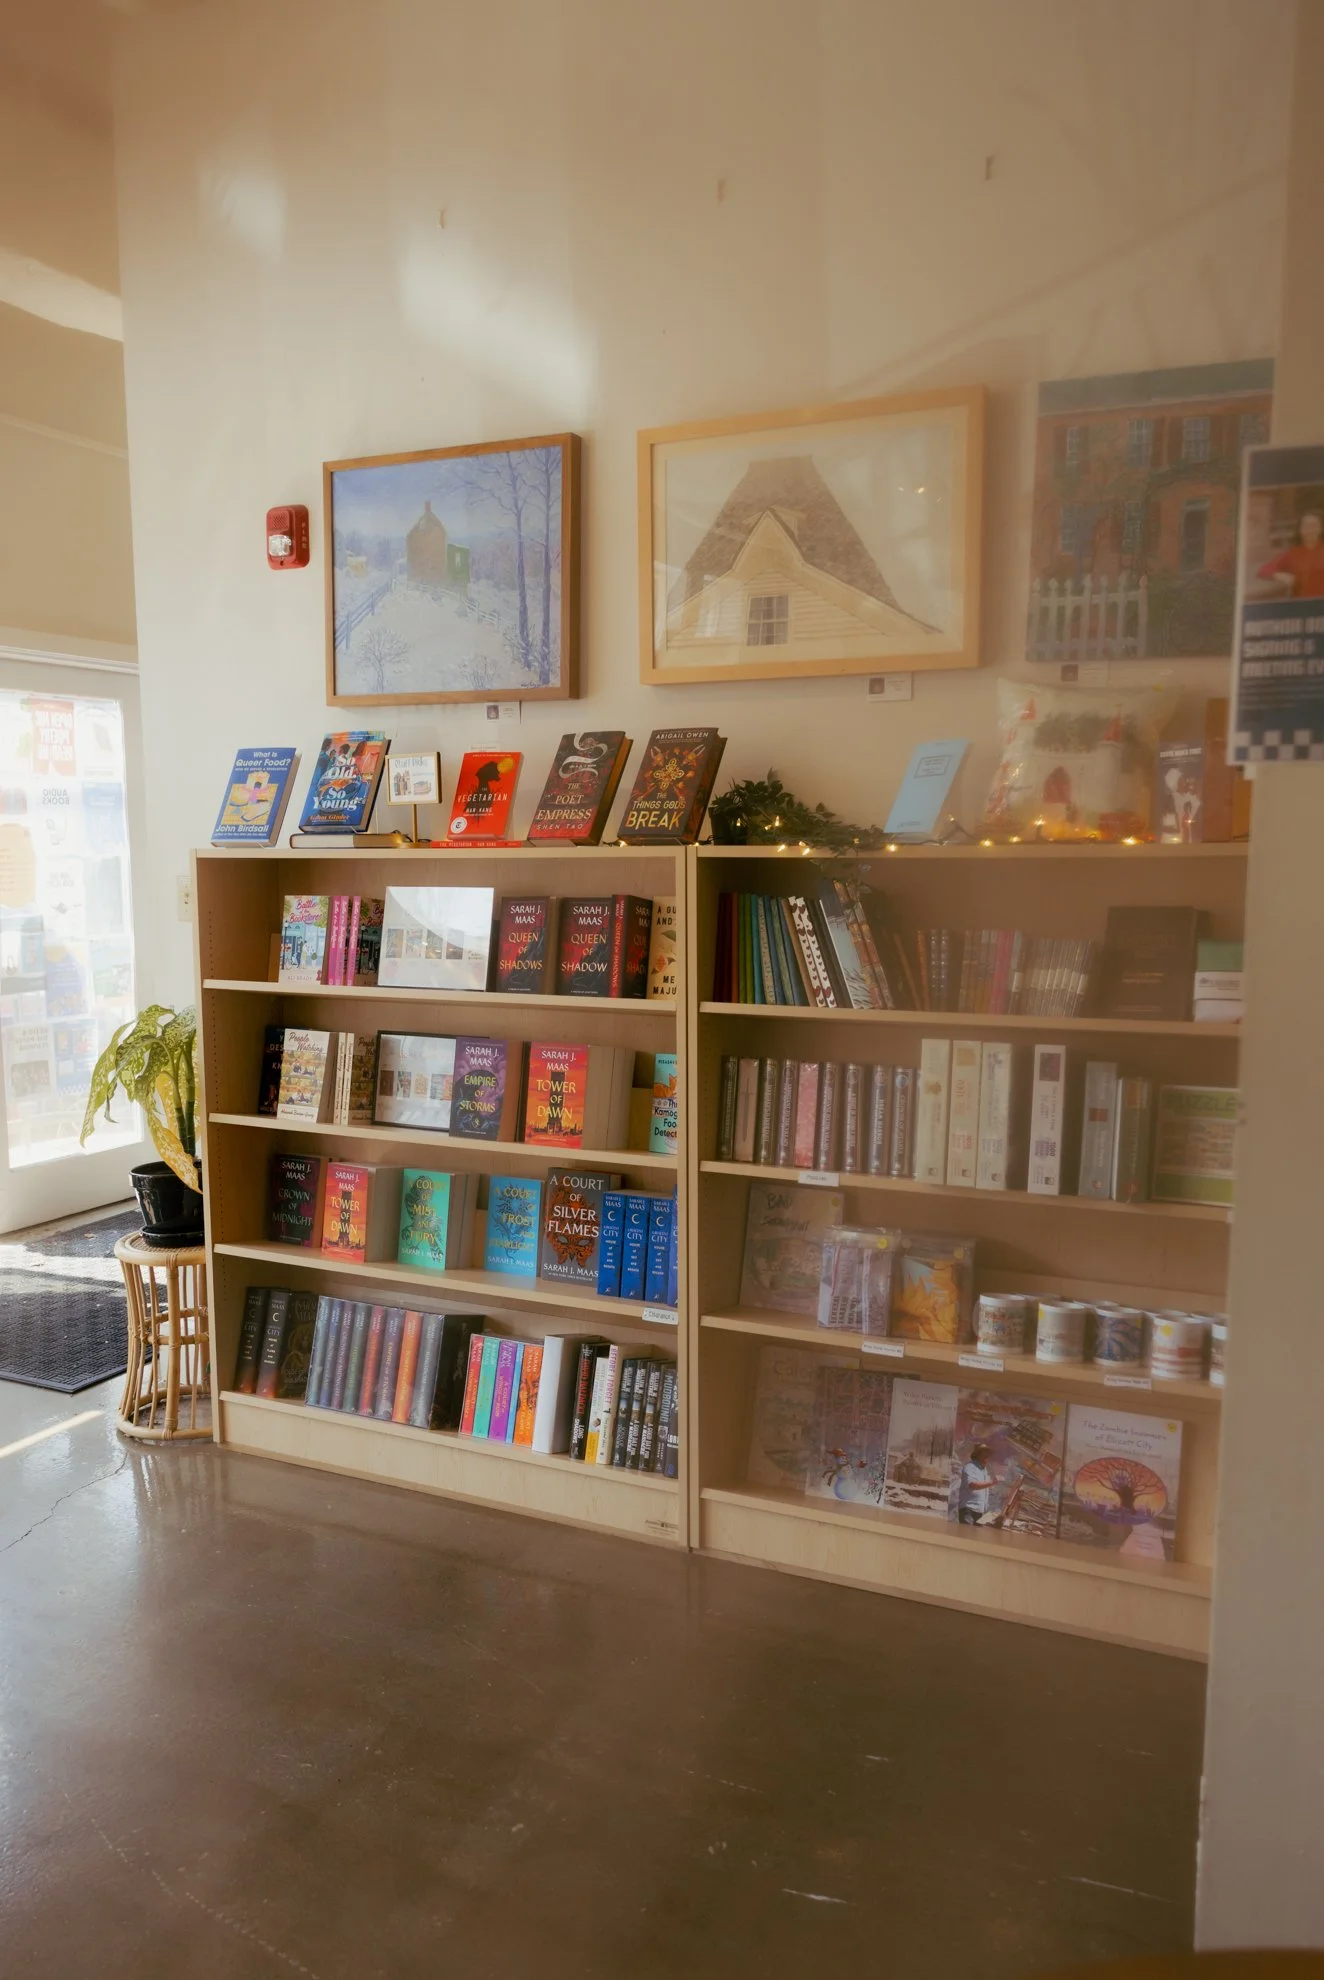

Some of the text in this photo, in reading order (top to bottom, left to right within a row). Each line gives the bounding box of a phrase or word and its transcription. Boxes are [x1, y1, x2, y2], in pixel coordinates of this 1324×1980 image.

[656, 731, 709, 740] ABIGAIL OWEN
[235, 758, 291, 767] Queer Food?
[335, 756, 356, 767] So
[567, 782, 580, 790] THE
[327, 787, 346, 799] So
[457, 793, 508, 802] VEGETARIAN
[312, 796, 358, 811] Young
[555, 794, 584, 805] POET
[632, 800, 687, 810] THINGS GODS
[536, 808, 592, 821] EMPRESS
[625, 810, 684, 831] BREAK
[237, 824, 269, 832] Birdsall
[296, 898, 317, 910] Battle
[510, 905, 542, 914] SARAH J.
[573, 906, 610, 916] SARAH J.
[657, 906, 662, 915] A
[288, 912, 323, 925] Bookstores
[514, 916, 536, 924] MAAS
[578, 916, 602, 925] MAAS
[656, 917, 673, 926] AND
[508, 932, 539, 943] QUEEN
[571, 933, 607, 945] QUEEN
[518, 945, 528, 954] OF
[583, 947, 593, 956] OF
[499, 959, 543, 970] SHADOWS
[561, 961, 607, 973] SHADOW
[612, 955, 620, 987] SHADOWS
[653, 986, 676, 995] MAJU
[288, 1032, 310, 1044] People
[296, 1041, 324, 1053] Watching
[465, 1045, 499, 1057] SARAH J.
[469, 1057, 492, 1066] MAAS
[541, 1050, 576, 1061] SARAH J.
[546, 1062, 569, 1071] MAAS
[464, 1075, 496, 1087] EMPIRE
[536, 1079, 576, 1093] TOWER
[550, 1094, 562, 1104] OF
[459, 1100, 495, 1113] STORMS
[537, 1105, 573, 1119] DAWN
[654, 1107, 677, 1119] Kamog
[663, 1118, 677, 1128] Foo
[654, 1127, 677, 1138] Detect
[281, 1161, 312, 1174] SARAH J.
[286, 1171, 306, 1180] MAAS
[335, 1171, 360, 1183] SARAH J.
[338, 1182, 355, 1192] MAAS
[549, 1175, 604, 1190] A COURT
[278, 1188, 310, 1201] CROWN
[503, 1187, 537, 1199] COURT
[569, 1193, 582, 1202] OF
[331, 1197, 360, 1212] TOWER
[340, 1211, 350, 1220] OF
[412, 1205, 436, 1217] MIST
[553, 1206, 596, 1222] SILVER
[272, 1212, 312, 1227] MIDNIGHT
[502, 1213, 536, 1227] FROST
[331, 1220, 358, 1234] DAWN
[548, 1221, 599, 1238] FLAMES
[410, 1230, 436, 1245] FURY
[627, 1233, 642, 1241] CITY
[651, 1235, 667, 1243] CITY
[489, 1237, 535, 1250] STARLIGHT
[488, 1255, 534, 1268] SARAH MAAS
[543, 1262, 568, 1273] SARAH
[577, 1268, 599, 1278] MAAS
[385, 1342, 393, 1365] EMPIRE
[607, 1348, 618, 1373] BEFORE
[604, 1379, 614, 1404] FORGET
[660, 1374, 673, 1422] MUDBOUND
[572, 1418, 580, 1444] SHADOWS
[577, 1425, 585, 1438] LONG
